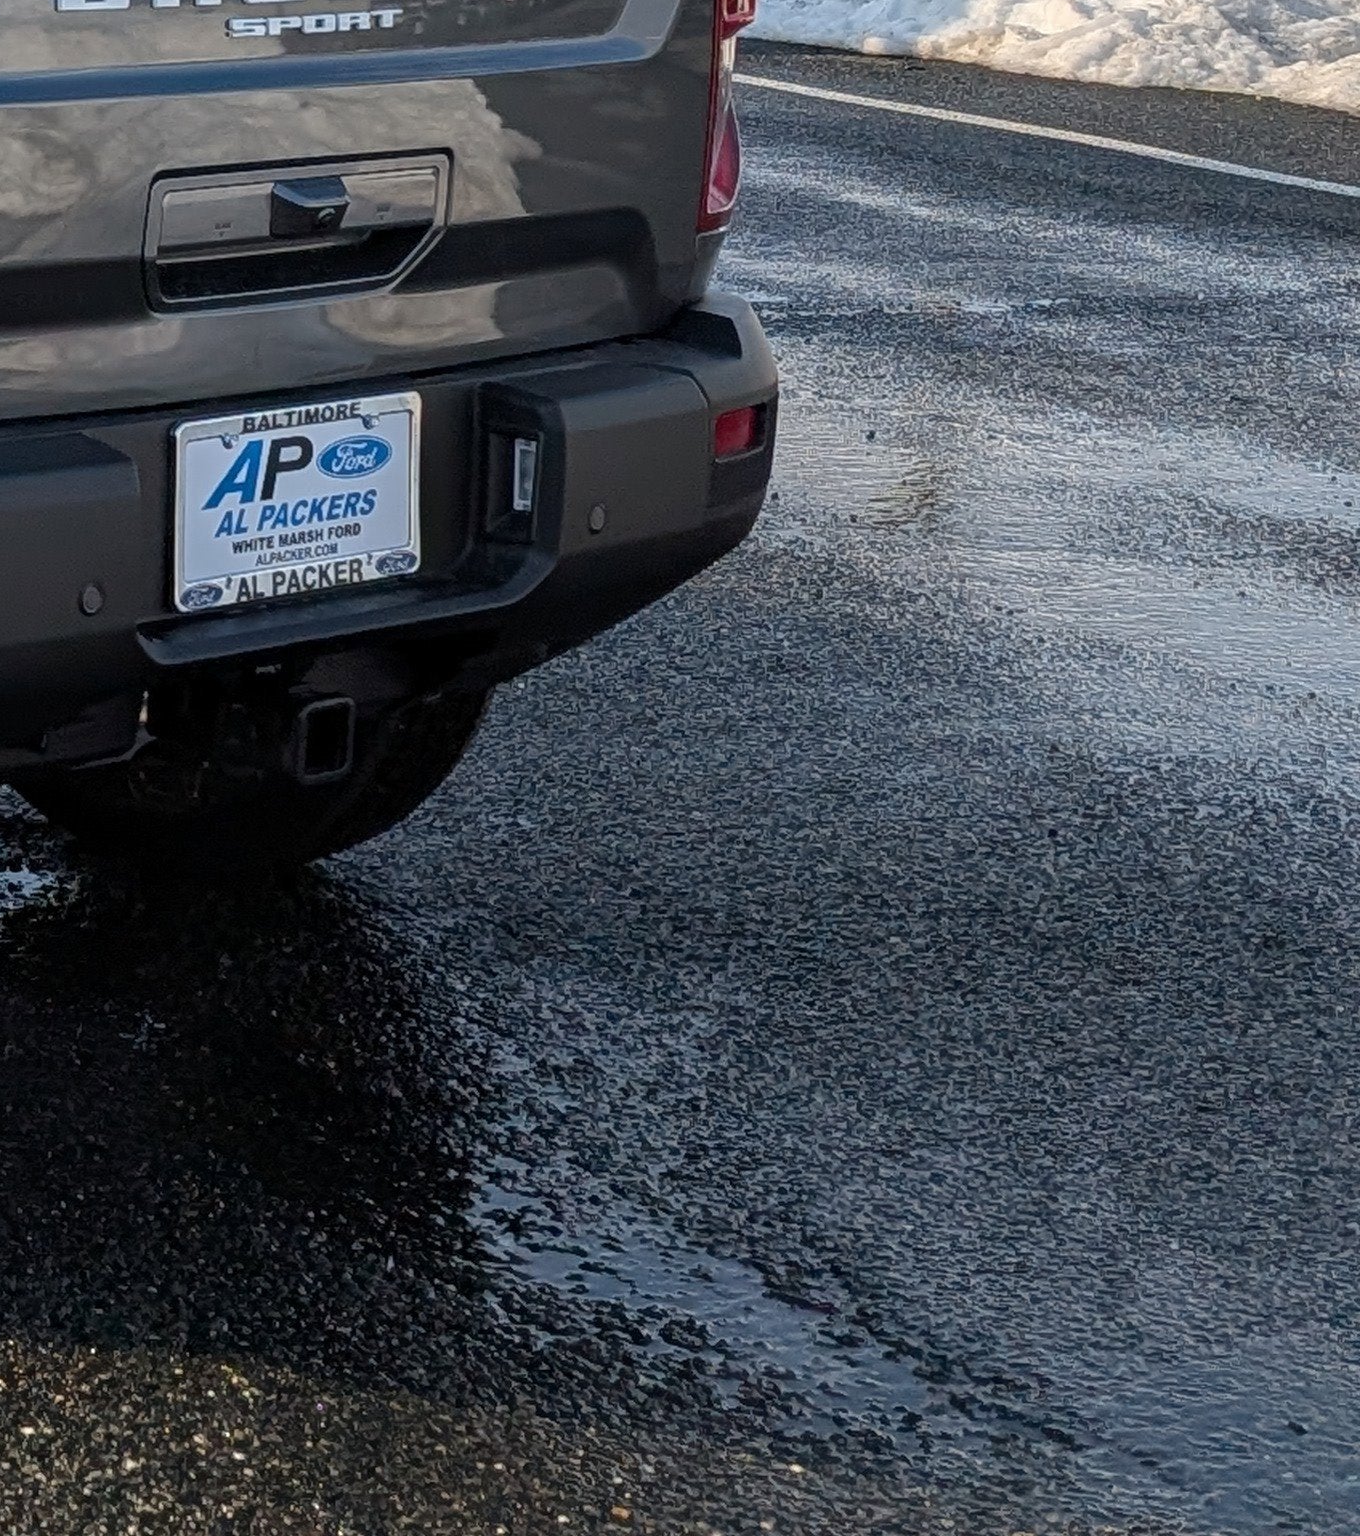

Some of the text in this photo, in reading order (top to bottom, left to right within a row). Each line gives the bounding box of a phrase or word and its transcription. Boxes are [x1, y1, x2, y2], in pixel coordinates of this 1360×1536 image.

[224, 7, 404, 39] SPORT
[241, 401, 363, 434] BALTIMORE
[201, 435, 380, 511] AP Ford
[213, 488, 378, 539] AL PACKERS
[232, 522, 362, 555] WHITE MARSH FORD
[254, 542, 340, 567] ALPACKER.COM
[235, 575, 266, 604] AL
[272, 557, 365, 597] PACKER
